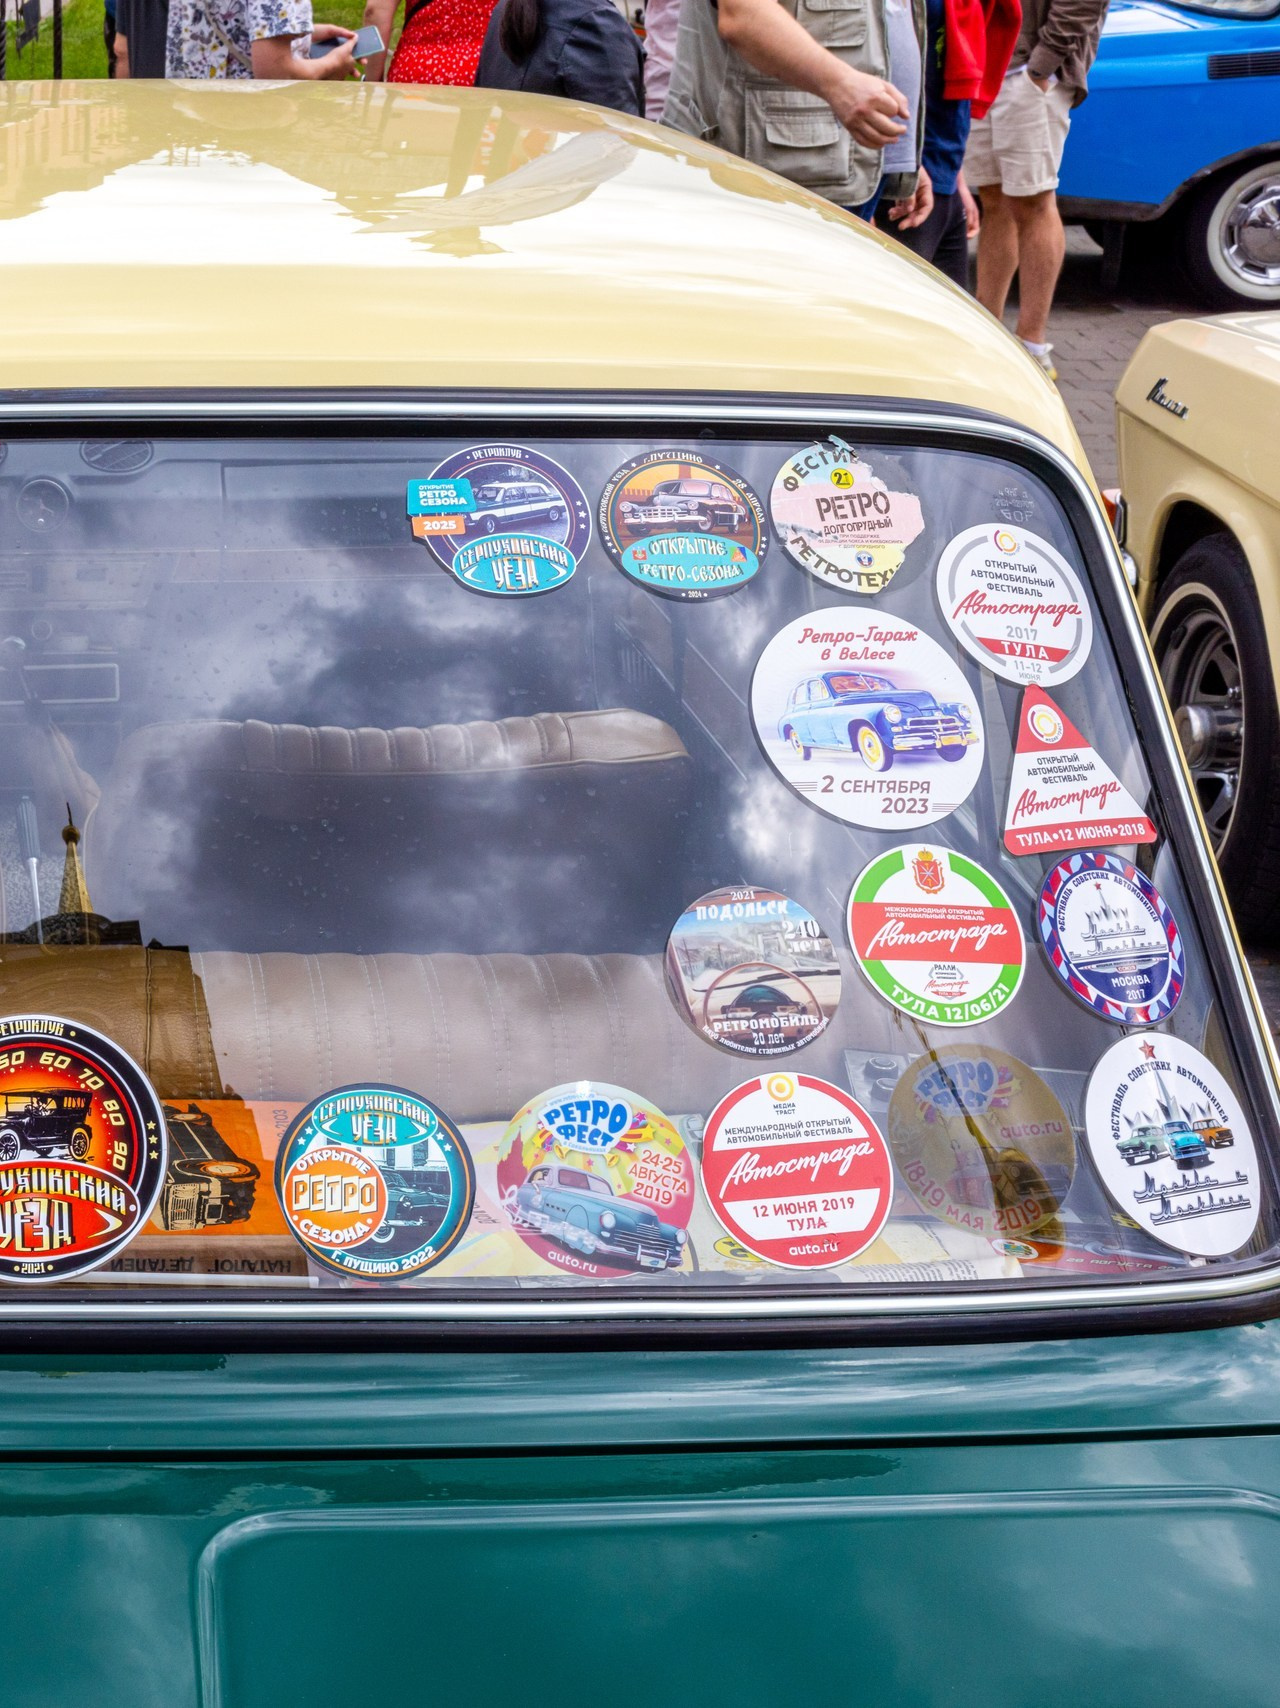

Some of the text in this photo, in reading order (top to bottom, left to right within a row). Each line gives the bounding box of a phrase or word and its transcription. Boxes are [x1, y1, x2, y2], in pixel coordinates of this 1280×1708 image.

[471, 448, 522, 460] РЕТРОКЛУБ
[418, 490, 457, 498] РЕТРО
[420, 497, 467, 506] СЕЗОНА
[815, 491, 891, 522] РЕТРО
[423, 520, 457, 531] 2025
[823, 515, 893, 537] ДОЛГОПРУДНЫЙ
[459, 537, 569, 571] СЕРПУХОВСКИЙ
[491, 556, 540, 591] УЕЗД
[984, 559, 1037, 574] ОТКРЫТЫЙ
[970, 569, 1055, 588] АВТОМОБИЛЬНЫЙ
[986, 582, 1043, 598] ФЕСТИВАЛЬ
[952, 589, 1082, 627] Автострада
[797, 626, 918, 647] Ретро-Гараж
[1006, 625, 1038, 641] 2017
[1001, 640, 1049, 660] ТУЛА
[1013, 660, 1043, 673] 11-12
[1018, 672, 1041, 681] ИЮНЯ
[1027, 762, 1096, 776] АВТОМОБИЛЬНЫЙ
[1036, 753, 1080, 766] ОТКРЫТЫЙ
[821, 775, 931, 794] 2 СЕНТЯБРЯ
[1042, 774, 1088, 785] ФЕСТИВАЛЬ
[881, 797, 929, 815] 2023
[1012, 781, 1121, 825] Автострада
[731, 890, 755, 901] 2021
[1059, 872, 1159, 932] ФЕСТИВАЛЬ СОВЕТСКИХ АВТОМОБИЛЕЙ
[695, 900, 788, 921] ПОДОЛЬСК
[884, 906, 984, 916] МЕЖДУНАРОДНЫЙ ОТКРЫТЫЙ
[885, 912, 945, 920] АВТОМОБИЛЬНЫЙ
[865, 919, 1007, 958] Автострада
[1111, 974, 1151, 988] МОСКВА
[891, 982, 1010, 1020] ТУЛА 12/06/21
[1126, 988, 1146, 1001] 2017
[713, 1014, 819, 1033] РЕТРОМОБИЛЬ
[753, 1032, 765, 1045] 20
[39, 1051, 72, 1069] 60
[78, 1068, 105, 1091] 70
[319, 1095, 431, 1127] СЕРПУХОВСКИЙ
[1111, 1061, 1229, 1141] ФЕСТИВАЛЬ СОВЕТСКИХ АВТОМОБИЛЕЙ
[102, 1099, 126, 1126] 80
[543, 1099, 628, 1134] РЕТРО
[351, 1113, 398, 1145] УЕЗД
[556, 1124, 614, 1147] ФЕСТ
[725, 1116, 851, 1136] МЕЖДУНАРОДНЫЙ ОТКРЫТЫЙ
[726, 1127, 853, 1144] АВТОМОБИЛЬНЫЙ ФЕСТИВАЛЬ
[1000, 1121, 1063, 1140] auto.ru
[112, 1141, 128, 1171] 90
[296, 1150, 371, 1174] ОТКРЫТИЕ
[642, 1149, 682, 1175] 24-25
[628, 1164, 688, 1194] АВГУСТА
[719, 1141, 874, 1199] Автострада
[293, 1174, 378, 1213] РЕТРО
[633, 1182, 673, 1205] 2019
[753, 1197, 855, 1218] 12 ИЮНЯ 2019
[946, 1198, 1042, 1231] МАЯ 2019
[299, 1218, 371, 1244] СЕЗОНА
[787, 1216, 827, 1231] ТУЛА
[789, 1241, 839, 1256] auto.ru
[20, 1262, 46, 1274] 2021
[343, 1245, 436, 1274] ПУЩИНО 2022
[547, 1250, 598, 1274] auto.ru
